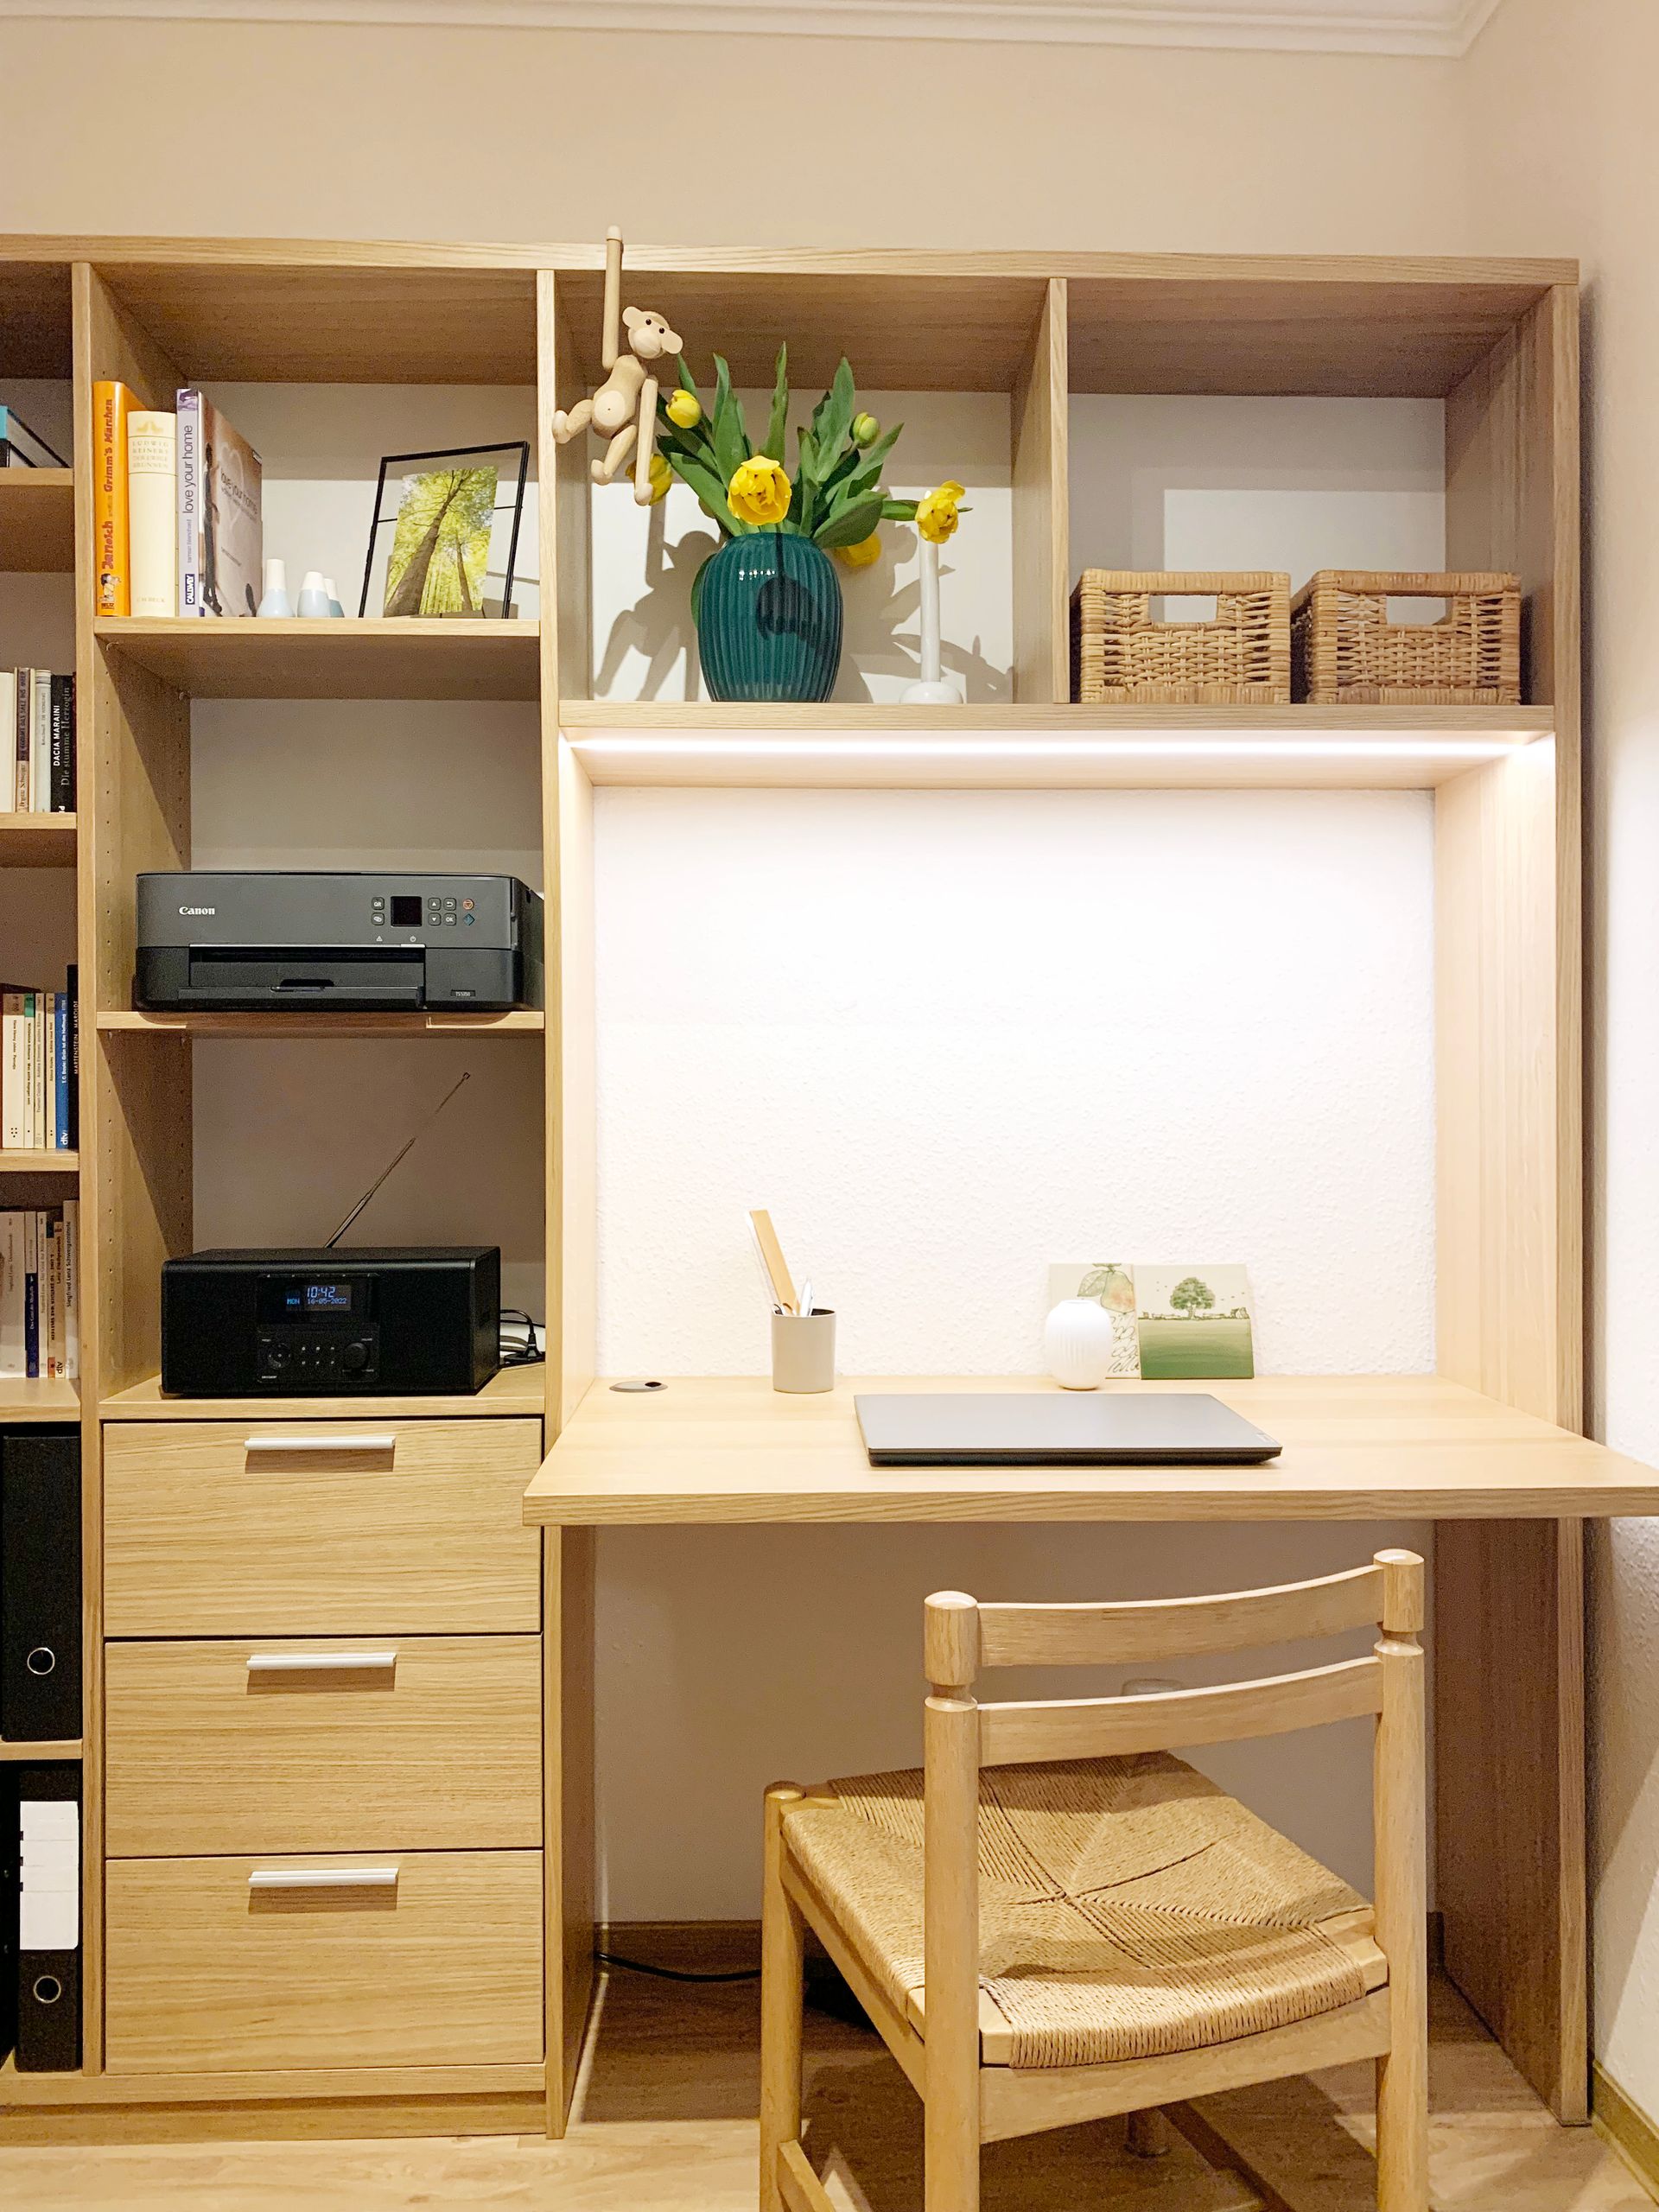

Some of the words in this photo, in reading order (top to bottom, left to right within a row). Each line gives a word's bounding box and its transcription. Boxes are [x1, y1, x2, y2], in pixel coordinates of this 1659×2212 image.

[104, 399, 113, 444] Märchen
[182, 425, 193, 459] home
[104, 447, 113, 492] Grimm's
[183, 461, 196, 487] your
[183, 490, 193, 513] love
[61, 687, 70, 729] Herzogin
[61, 769, 69, 786] Die
[178, 906, 215, 915] Canon
[307, 1286, 335, 1298] 10:42
